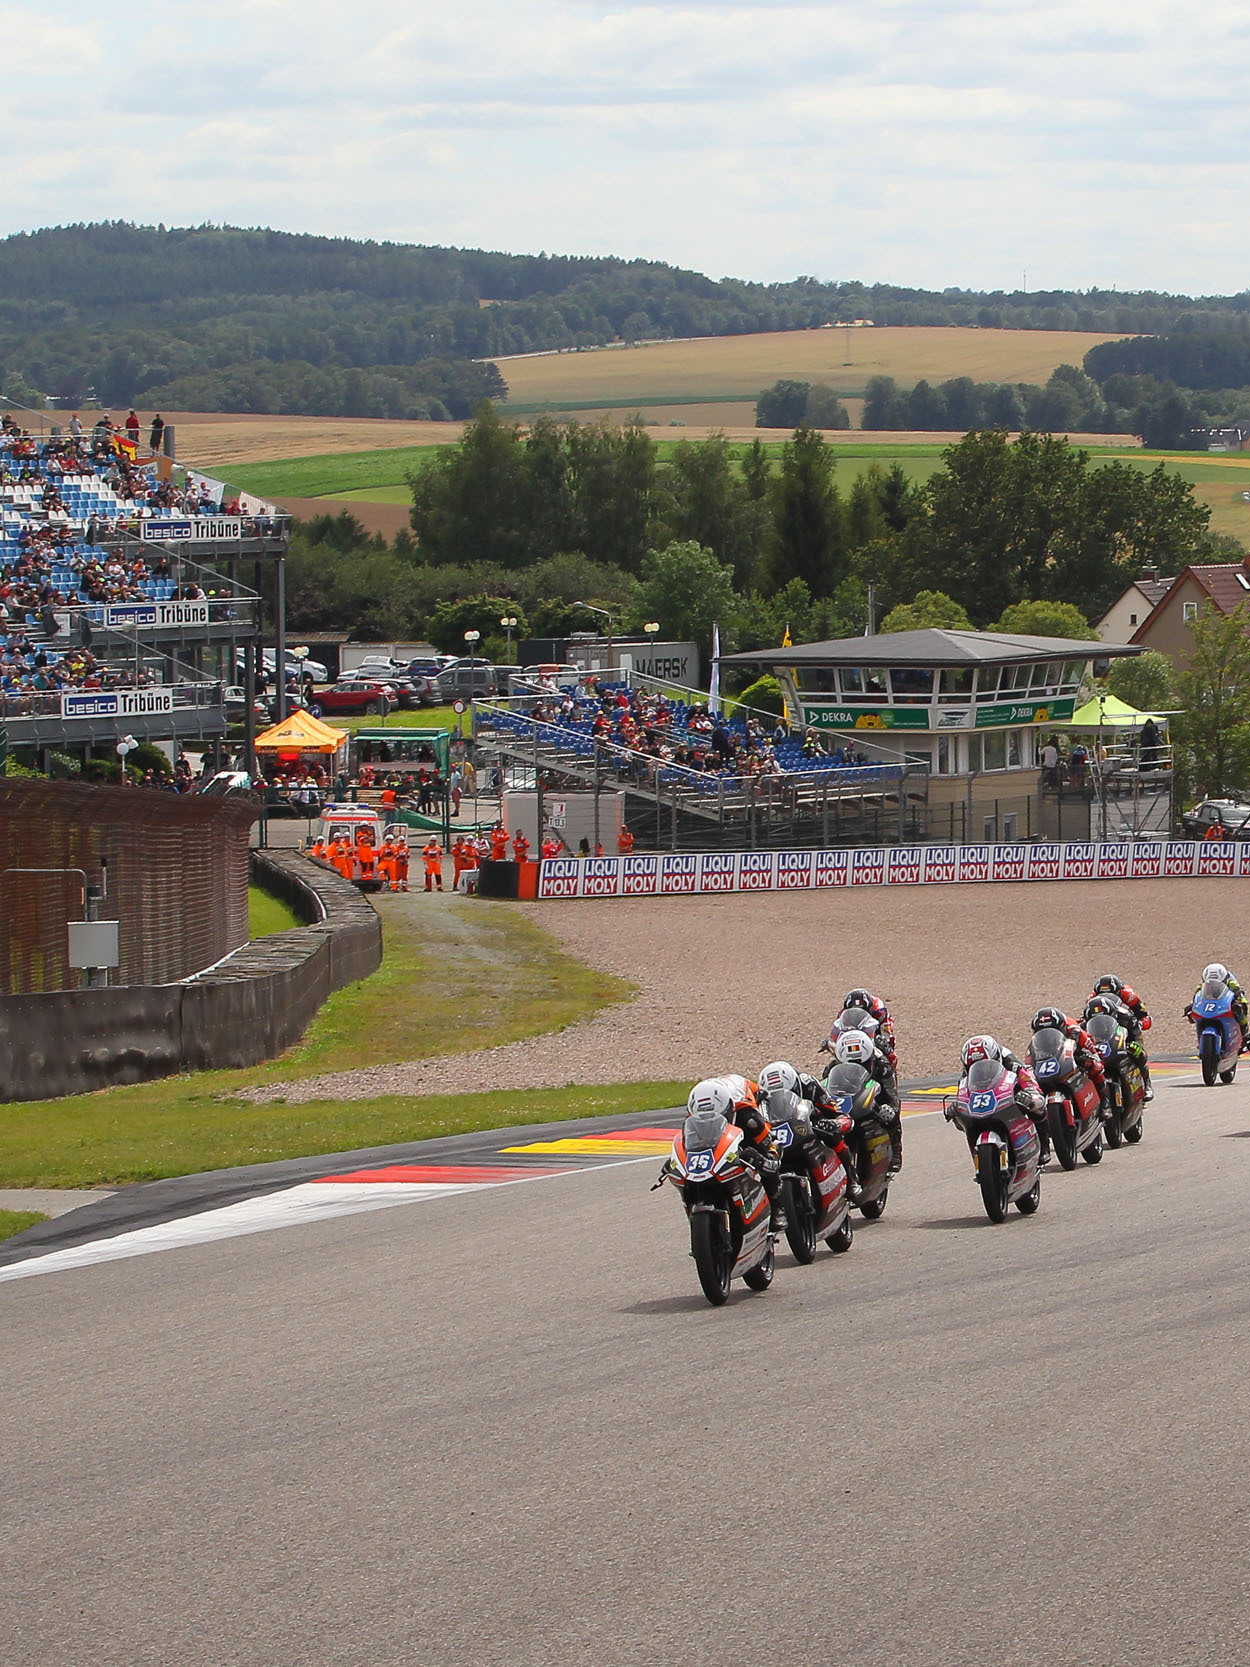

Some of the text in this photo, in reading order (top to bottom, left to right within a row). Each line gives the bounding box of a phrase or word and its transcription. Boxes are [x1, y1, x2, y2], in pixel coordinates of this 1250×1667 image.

[144, 519, 239, 538] besico Tribüne
[108, 604, 206, 624] besico Tribüne
[636, 657, 688, 679] MAERSK
[66, 692, 170, 714] besico Tribüne
[822, 713, 853, 722] DEKRA
[854, 850, 884, 867] LIQUI
[891, 849, 921, 866] LIQUI
[926, 848, 955, 865] LIQUI
[961, 847, 989, 864] LIQUI
[995, 847, 1025, 863] LIQUI
[1031, 846, 1060, 862] LIQUI
[1066, 845, 1094, 861] LIQUI
[1101, 845, 1128, 861] LIQUI
[1134, 844, 1161, 860] LIQUI
[1167, 843, 1193, 859] LIQUI
[1201, 843, 1235, 859] LIQUI
[545, 860, 579, 878] LIQUI
[586, 859, 618, 877] LIQUI
[625, 857, 657, 875] LIQUI
[664, 856, 697, 874] LIQUI
[703, 855, 735, 873] LIQUI
[741, 854, 773, 872] LIQUI
[780, 854, 811, 871] LIQUI
[817, 852, 848, 869] LIQUI
[1030, 861, 1059, 877] MOLY
[1065, 860, 1093, 877] MOLY
[1100, 860, 1127, 876] MOLY
[1133, 859, 1160, 875] MOLY
[1166, 858, 1192, 874] MOLY
[1200, 858, 1234, 875] MOLY
[779, 870, 810, 888] MOLY
[816, 868, 847, 885] MOLY
[853, 866, 883, 884] MOLY
[890, 865, 920, 883] MOLY
[925, 864, 954, 882] MOLY
[960, 863, 988, 880] MOLY
[994, 862, 1024, 879] MOLY
[544, 877, 578, 896] MOLY
[585, 876, 617, 894] MOLY
[624, 874, 656, 893] MOLY
[663, 873, 696, 892] MOLY
[702, 872, 734, 890] MOLY
[740, 871, 772, 889] MOLY
[1205, 1003, 1216, 1012] 12
[1039, 1062, 1056, 1073] 42
[973, 1095, 991, 1108] 53
